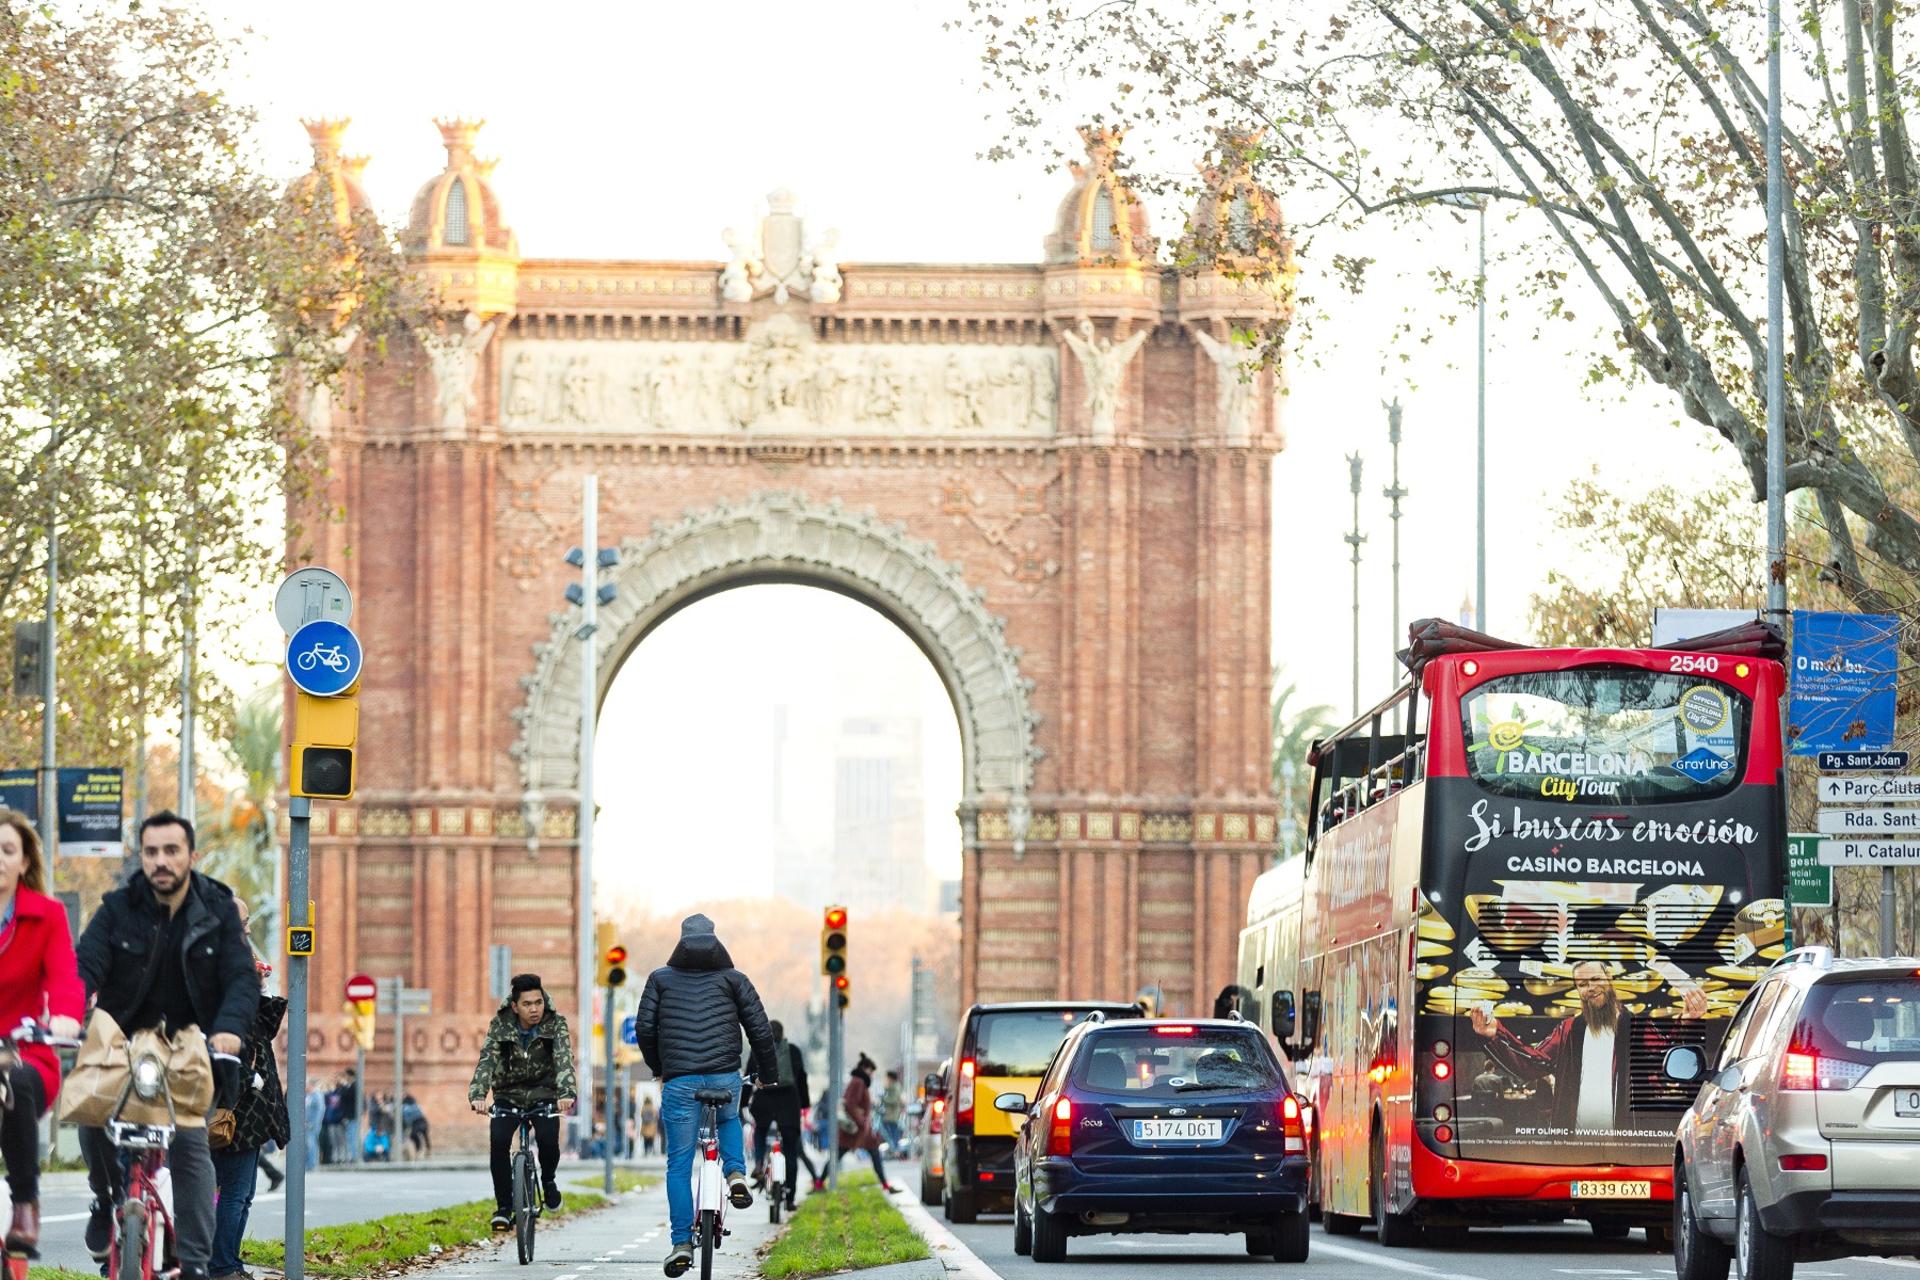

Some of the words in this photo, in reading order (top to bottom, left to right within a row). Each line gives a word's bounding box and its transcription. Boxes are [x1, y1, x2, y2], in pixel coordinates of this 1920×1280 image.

[1670, 655, 1719, 673] 2540
[1693, 694, 1720, 708] OFFICIAL
[1685, 702, 1722, 718] BARCELONA
[1508, 752, 1648, 776] BARCELONA
[1827, 755, 1844, 768] Pg.
[1847, 755, 1872, 766] Sant
[1875, 755, 1901, 766] Joan
[1845, 781, 1878, 795] Parc
[1464, 799, 1506, 852] Si
[1513, 806, 1624, 842] buscas
[1632, 817, 1758, 845] emoción
[1845, 812, 1878, 826] Rda.
[1883, 812, 1917, 826] Sant
[1845, 844, 1863, 858] Pl.
[1507, 855, 1582, 873] CASINO
[1587, 859, 1705, 877] BARCELONA
[1144, 1122, 1183, 1137] 5174
[1187, 1122, 1216, 1137] DGT
[1515, 1127, 1536, 1135] PORT
[1537, 1126, 1568, 1136] OLÍMPIC
[1581, 1183, 1616, 1196] 8339
[1620, 1183, 1647, 1196] GXX
